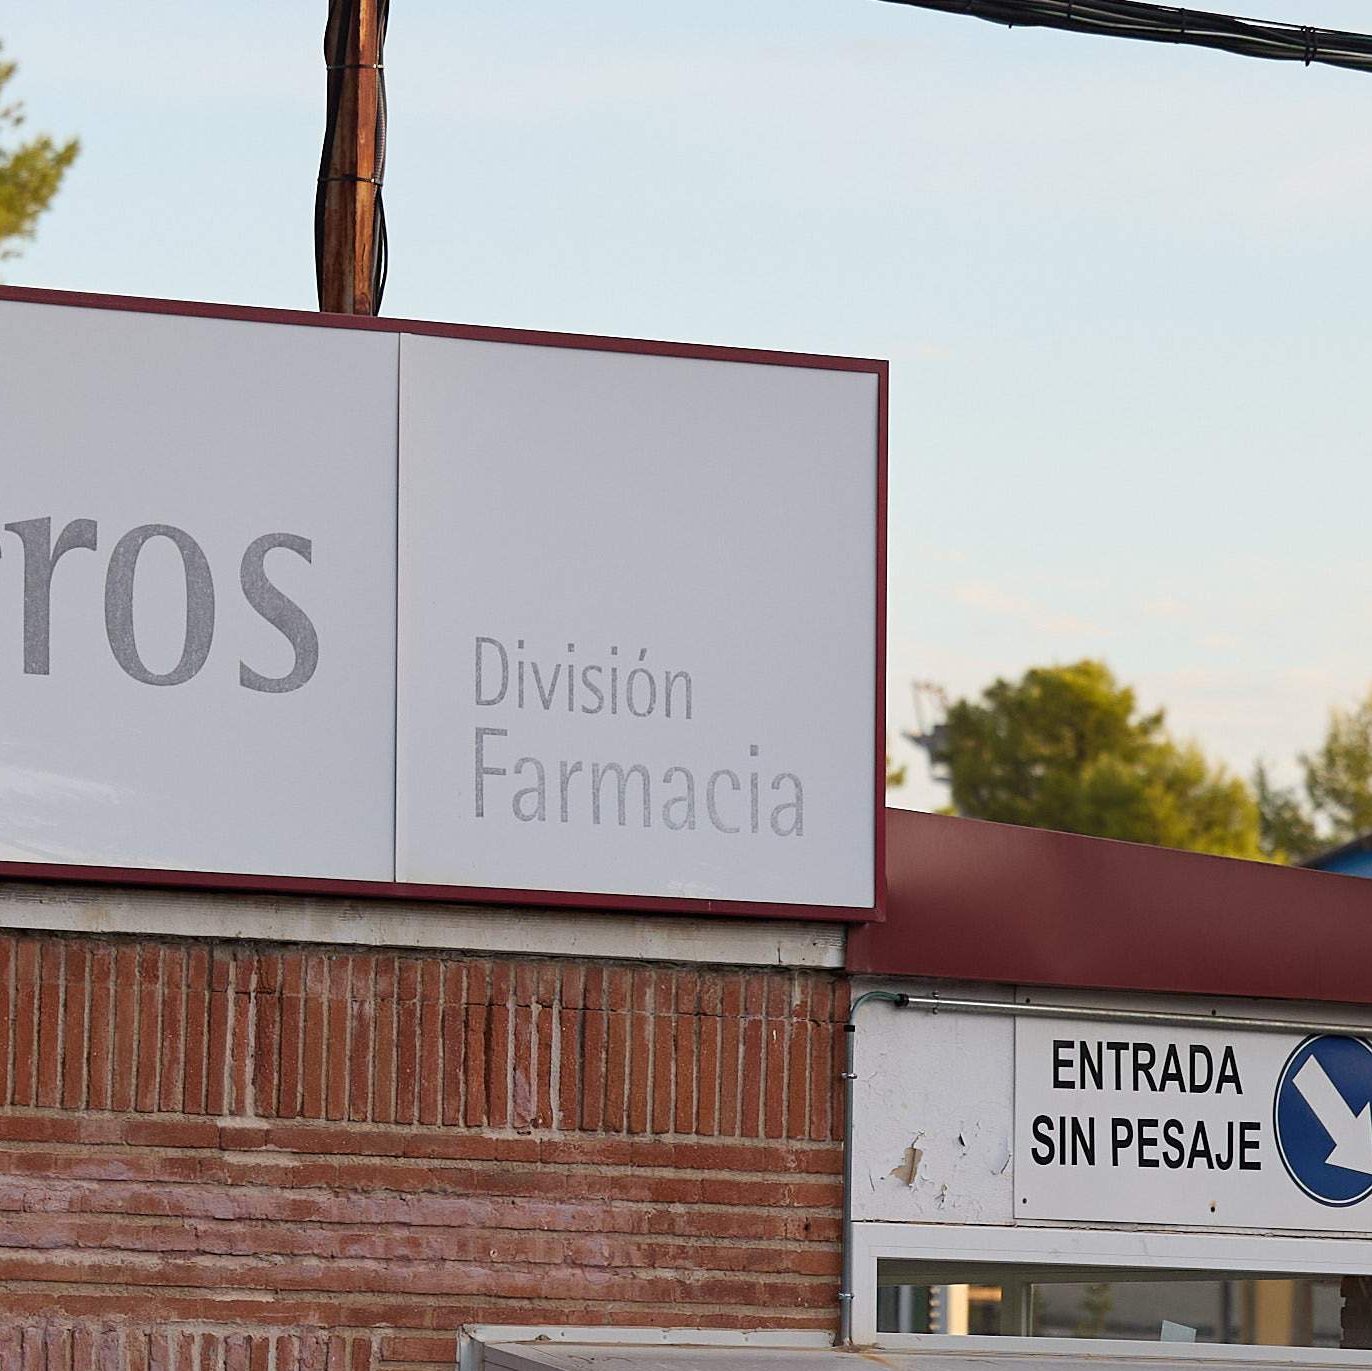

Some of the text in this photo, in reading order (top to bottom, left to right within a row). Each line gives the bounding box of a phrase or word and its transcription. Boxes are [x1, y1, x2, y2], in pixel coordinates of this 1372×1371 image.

[473, 635, 695, 721] División
[473, 727, 806, 837] Farmacia
[1052, 1039, 1244, 1095] ENTRADA
[1031, 1114, 1262, 1171] SIN PESAJE
